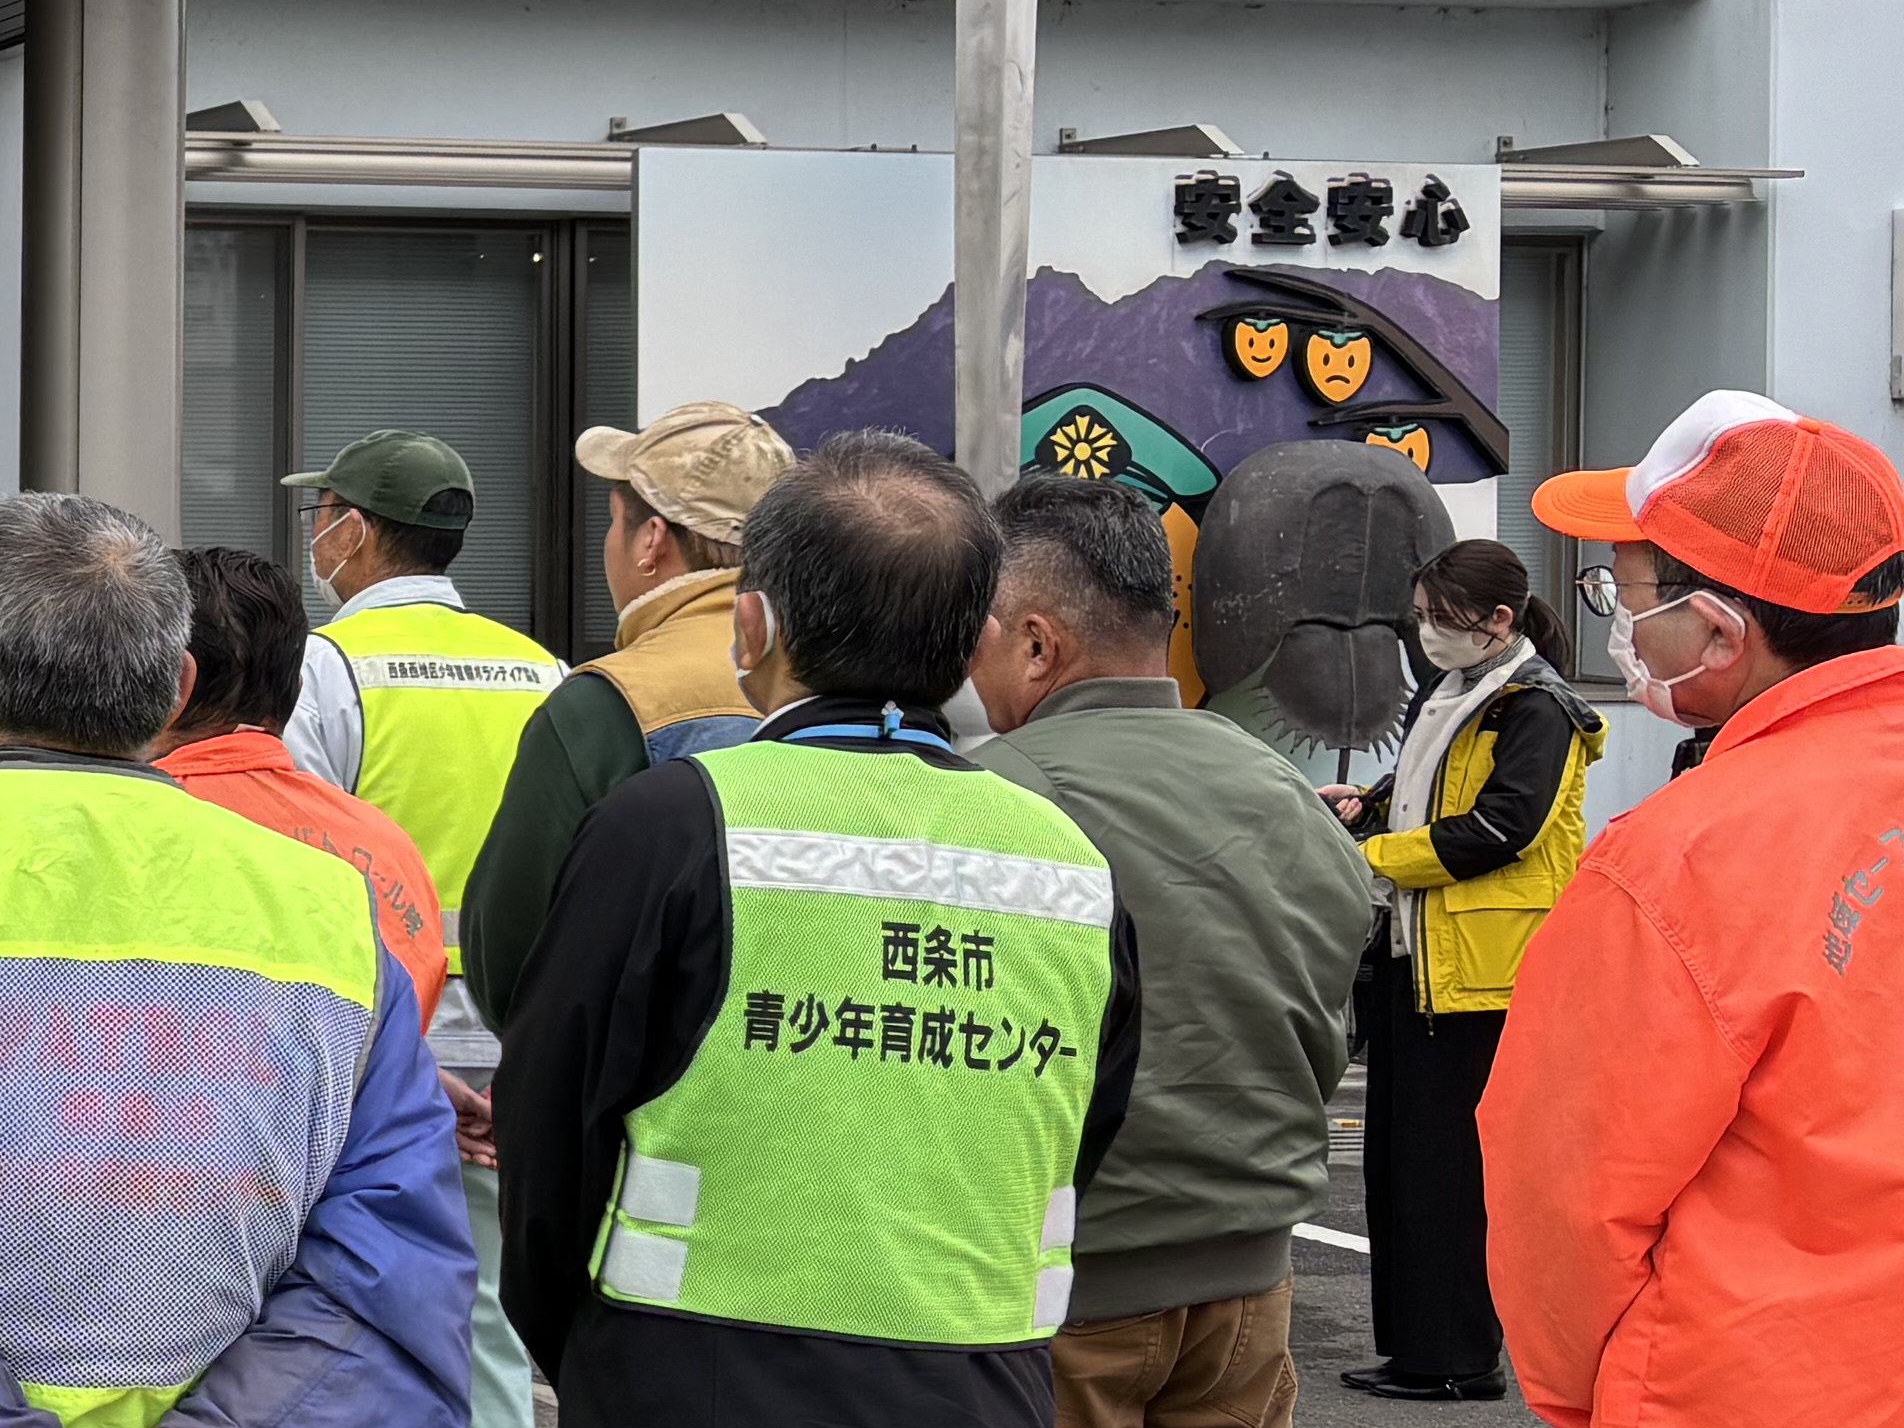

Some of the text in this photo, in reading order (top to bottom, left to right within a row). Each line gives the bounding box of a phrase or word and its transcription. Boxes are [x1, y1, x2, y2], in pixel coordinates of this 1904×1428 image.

[1173, 169, 1471, 248] 安全安心
[881, 921, 994, 991] 西条市
[744, 989, 1077, 1078] 青少年育成センター
